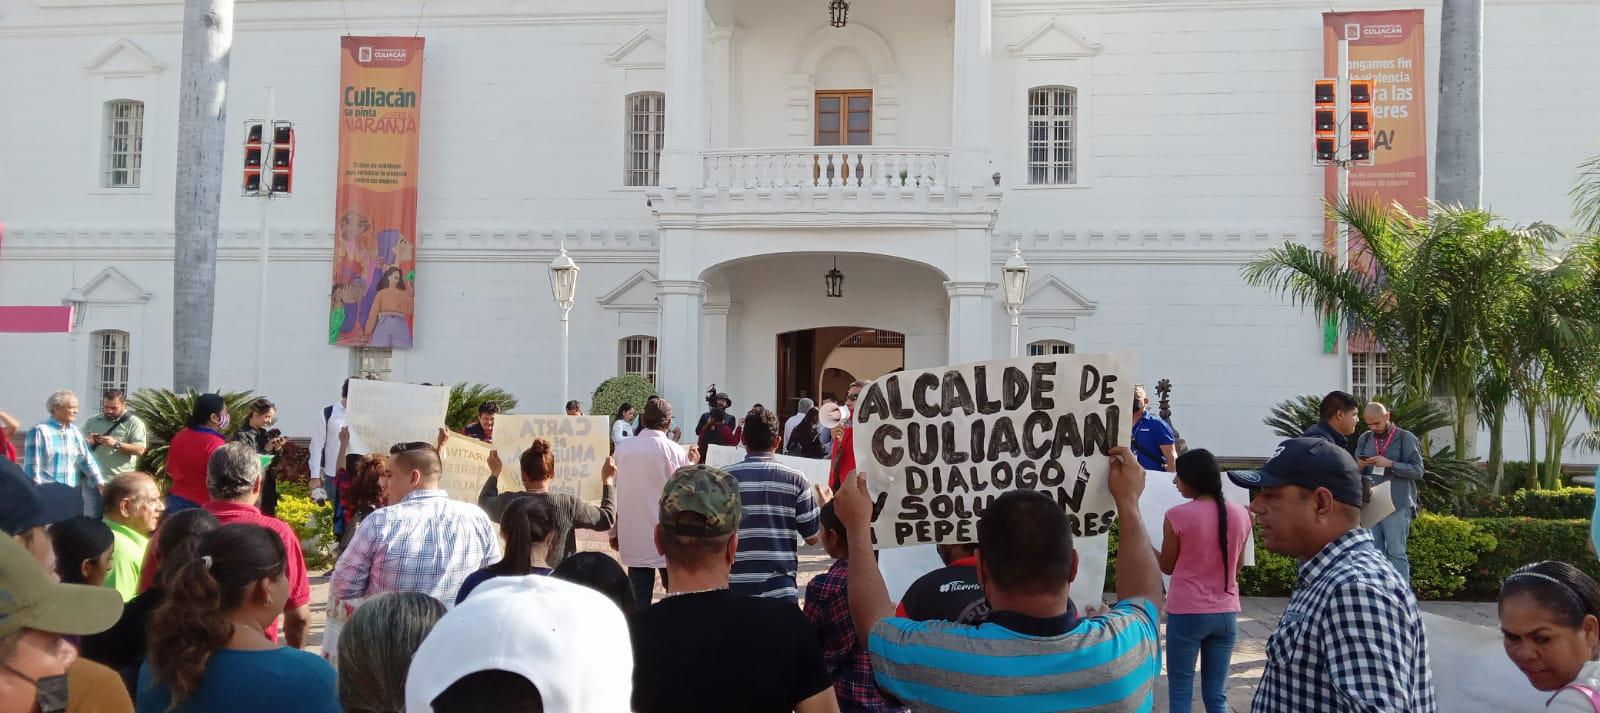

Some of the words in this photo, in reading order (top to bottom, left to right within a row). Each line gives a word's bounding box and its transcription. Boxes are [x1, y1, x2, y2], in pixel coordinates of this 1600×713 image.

[1347, 59, 1395, 71] ongamos
[1397, 57, 1412, 69] fin
[343, 86, 416, 109] Culiacán
[1392, 85, 1413, 101] las
[344, 108, 354, 117] se
[355, 108, 377, 119] pinta
[1375, 105, 1409, 119] eres
[343, 114, 417, 136] NARANJA
[1374, 129, 1395, 151] A!
[858, 361, 1057, 423] ALCALDE
[1080, 364, 1118, 405] DE
[872, 405, 1120, 467] CULIACAN
[904, 459, 1066, 496] DIALOGO
